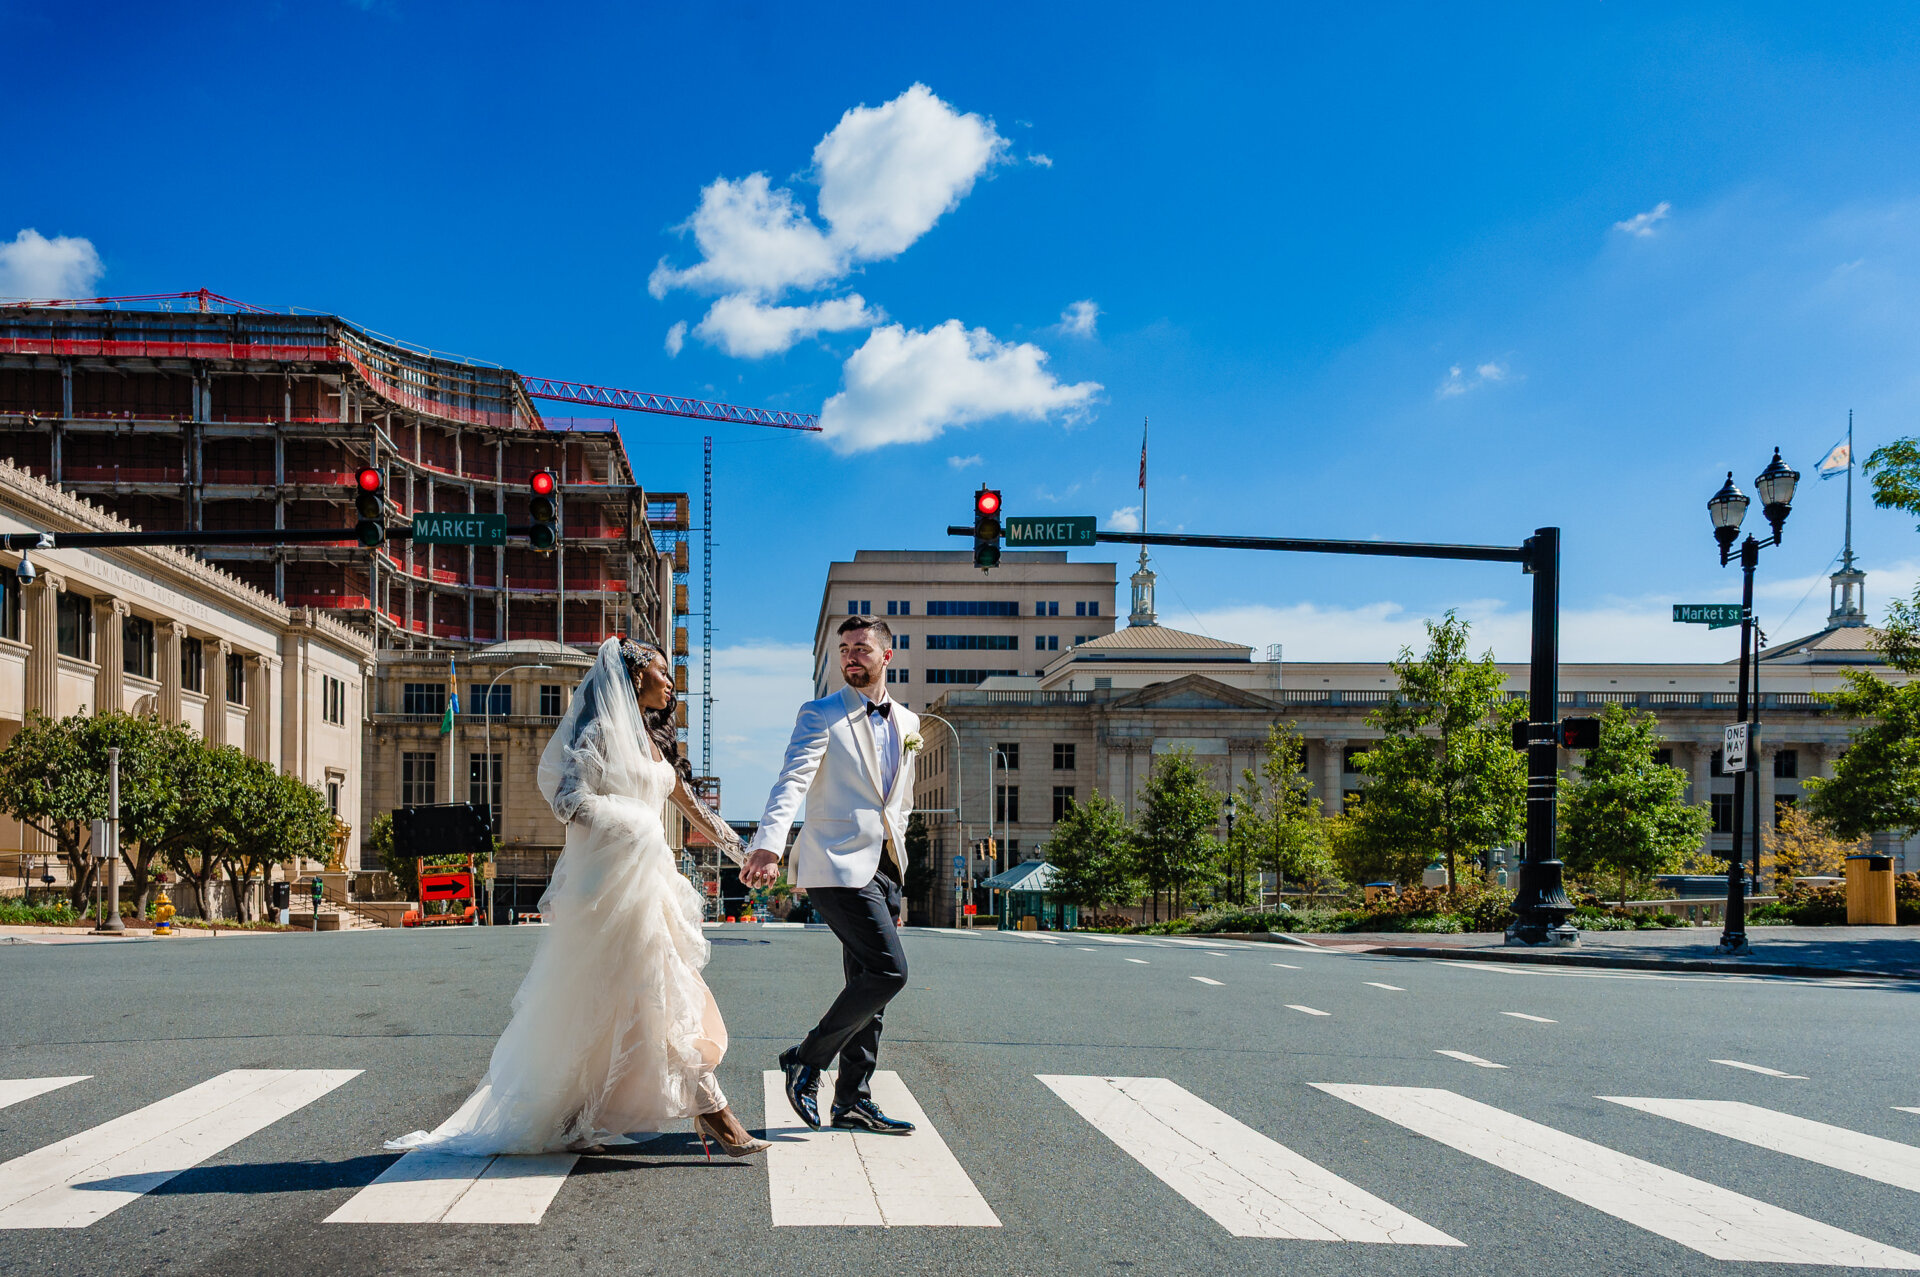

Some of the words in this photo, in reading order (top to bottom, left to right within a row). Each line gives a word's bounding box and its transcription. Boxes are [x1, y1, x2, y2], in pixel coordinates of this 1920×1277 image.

[416, 519, 485, 538] MARKET
[491, 528, 502, 539] ST
[1011, 523, 1075, 540] MARKET
[1080, 530, 1091, 539] ST
[83, 555, 146, 594] WILMINGTON
[152, 586, 176, 608] TRUST
[1682, 606, 1723, 620] Market
[1727, 727, 1744, 740] ONE
[1726, 740, 1744, 752] WAY
